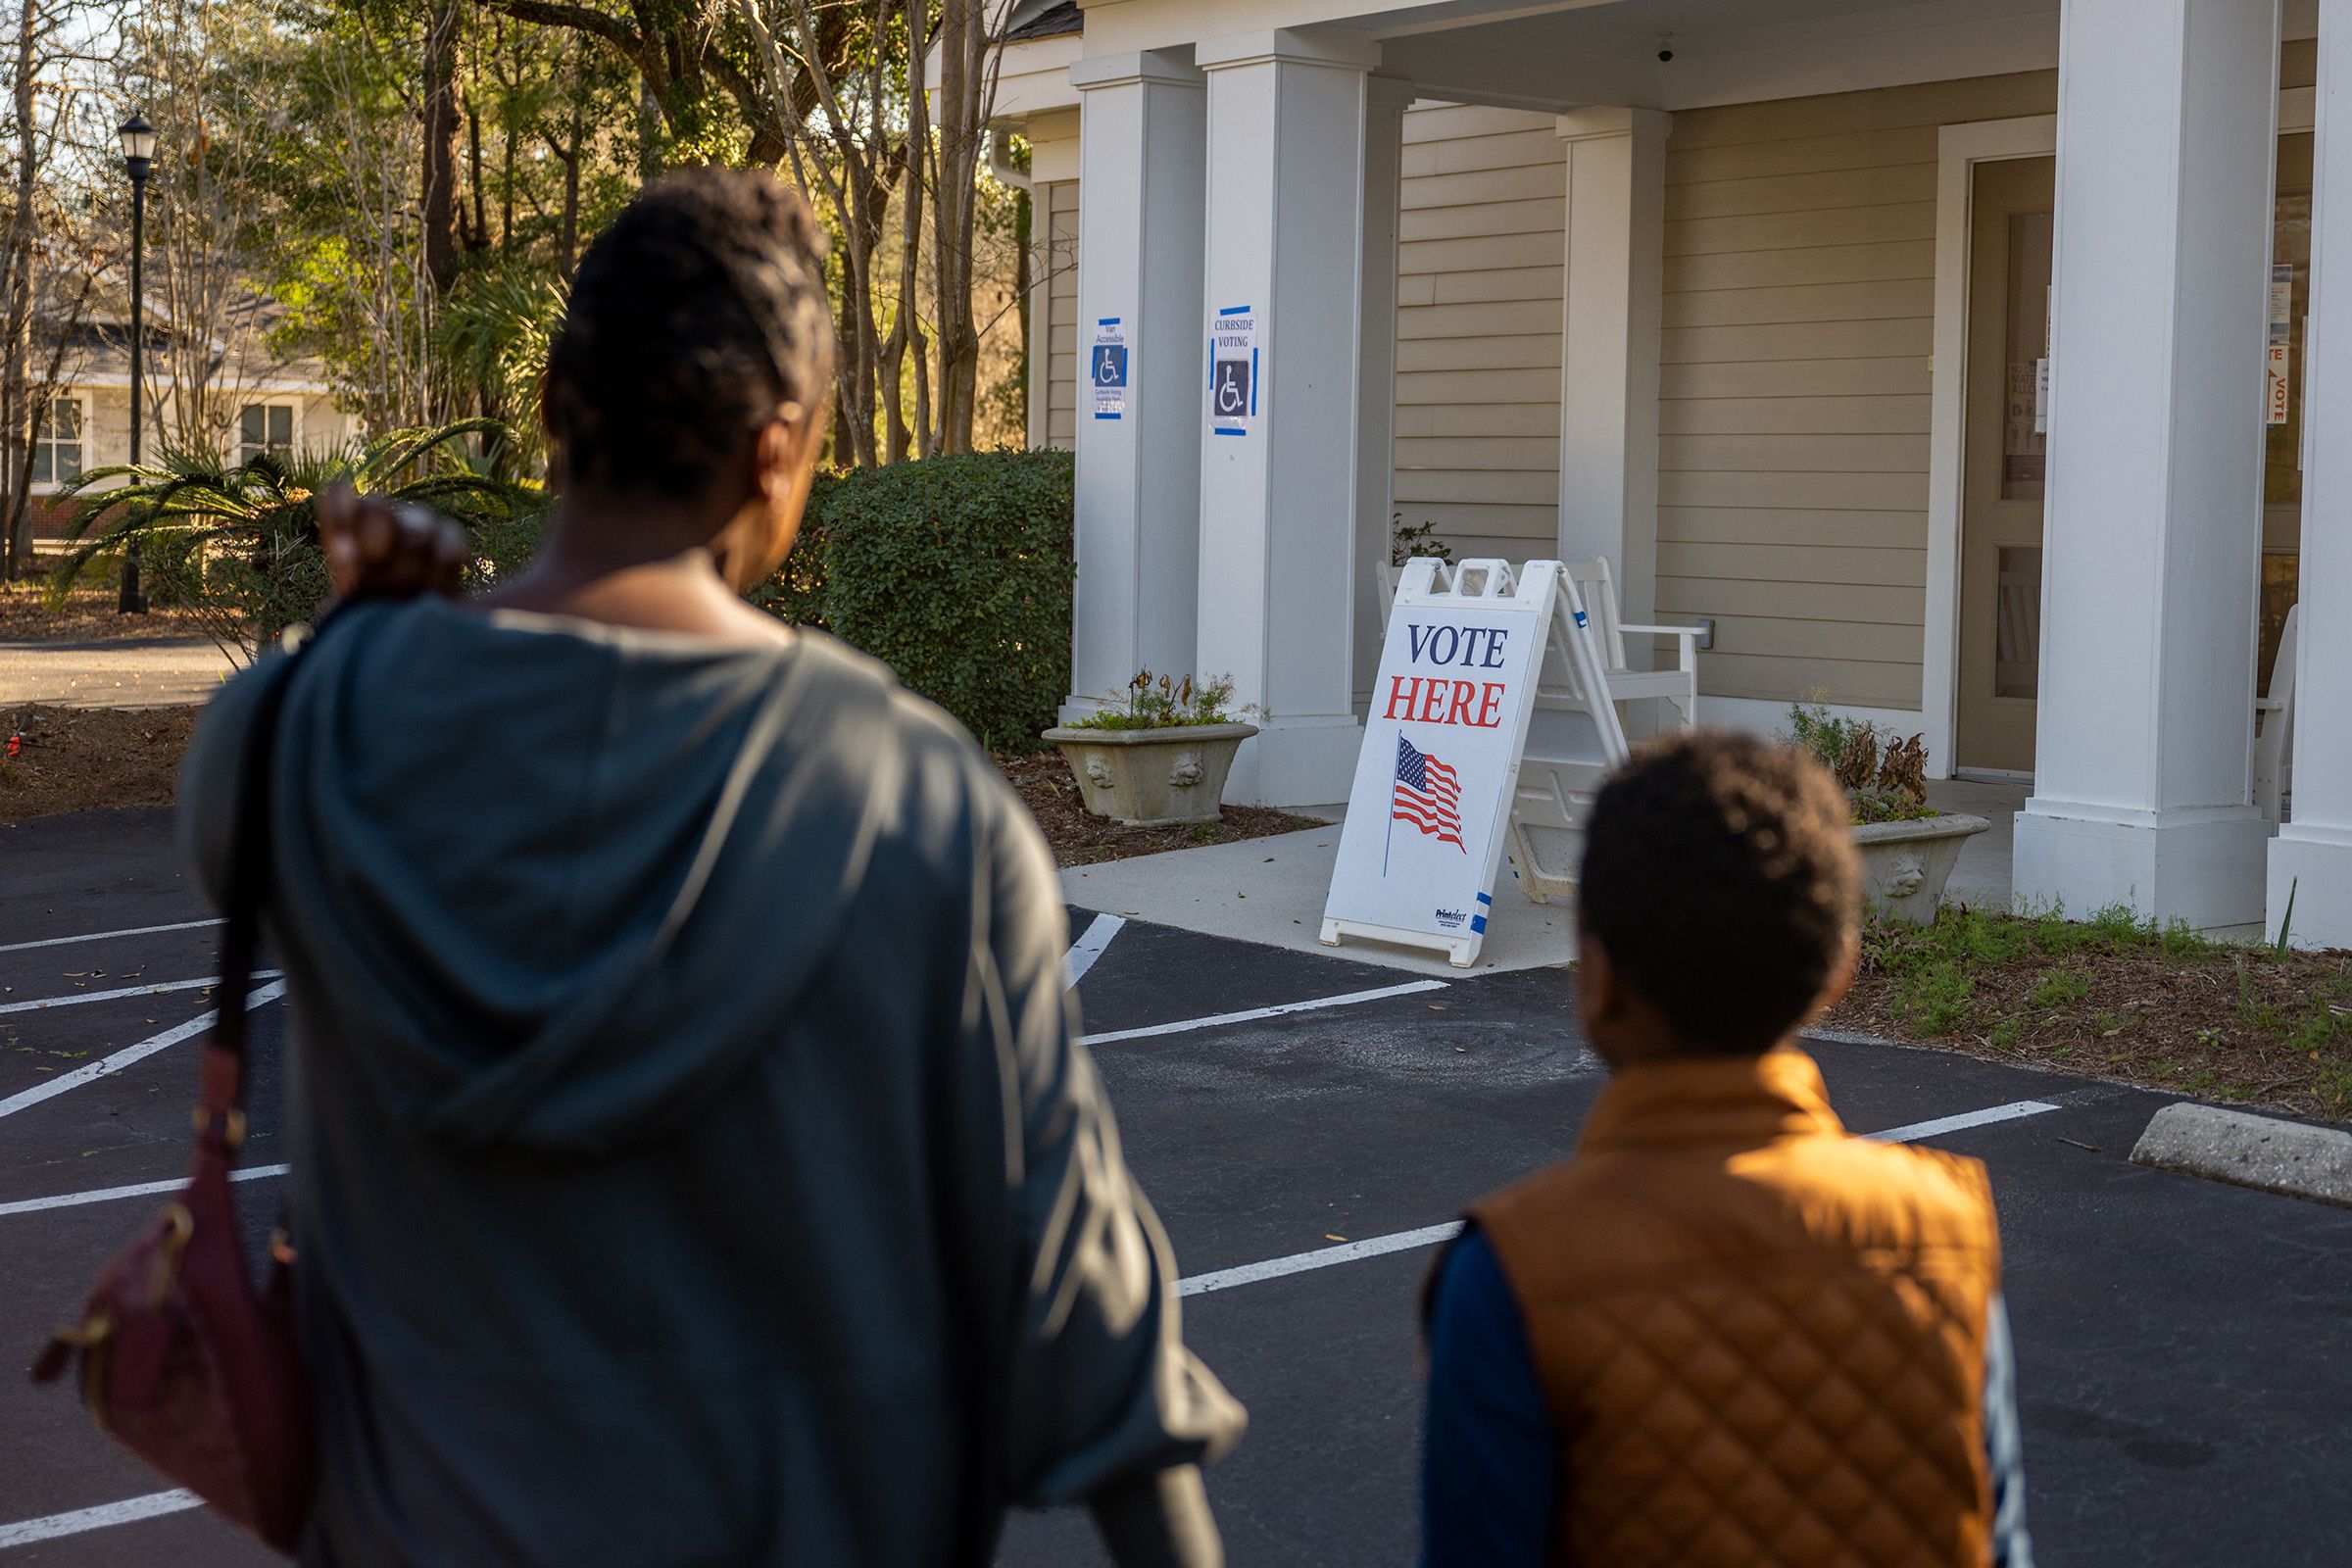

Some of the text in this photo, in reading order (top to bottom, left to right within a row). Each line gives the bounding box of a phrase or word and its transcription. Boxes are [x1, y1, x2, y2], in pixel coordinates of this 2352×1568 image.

[1215, 319, 1253, 330] CURBSIDE
[1218, 336, 1248, 347] VOTING
[2275, 378, 2286, 421] VOTE
[1408, 624, 1508, 668] VOTE
[1383, 676, 1505, 728] HERE
